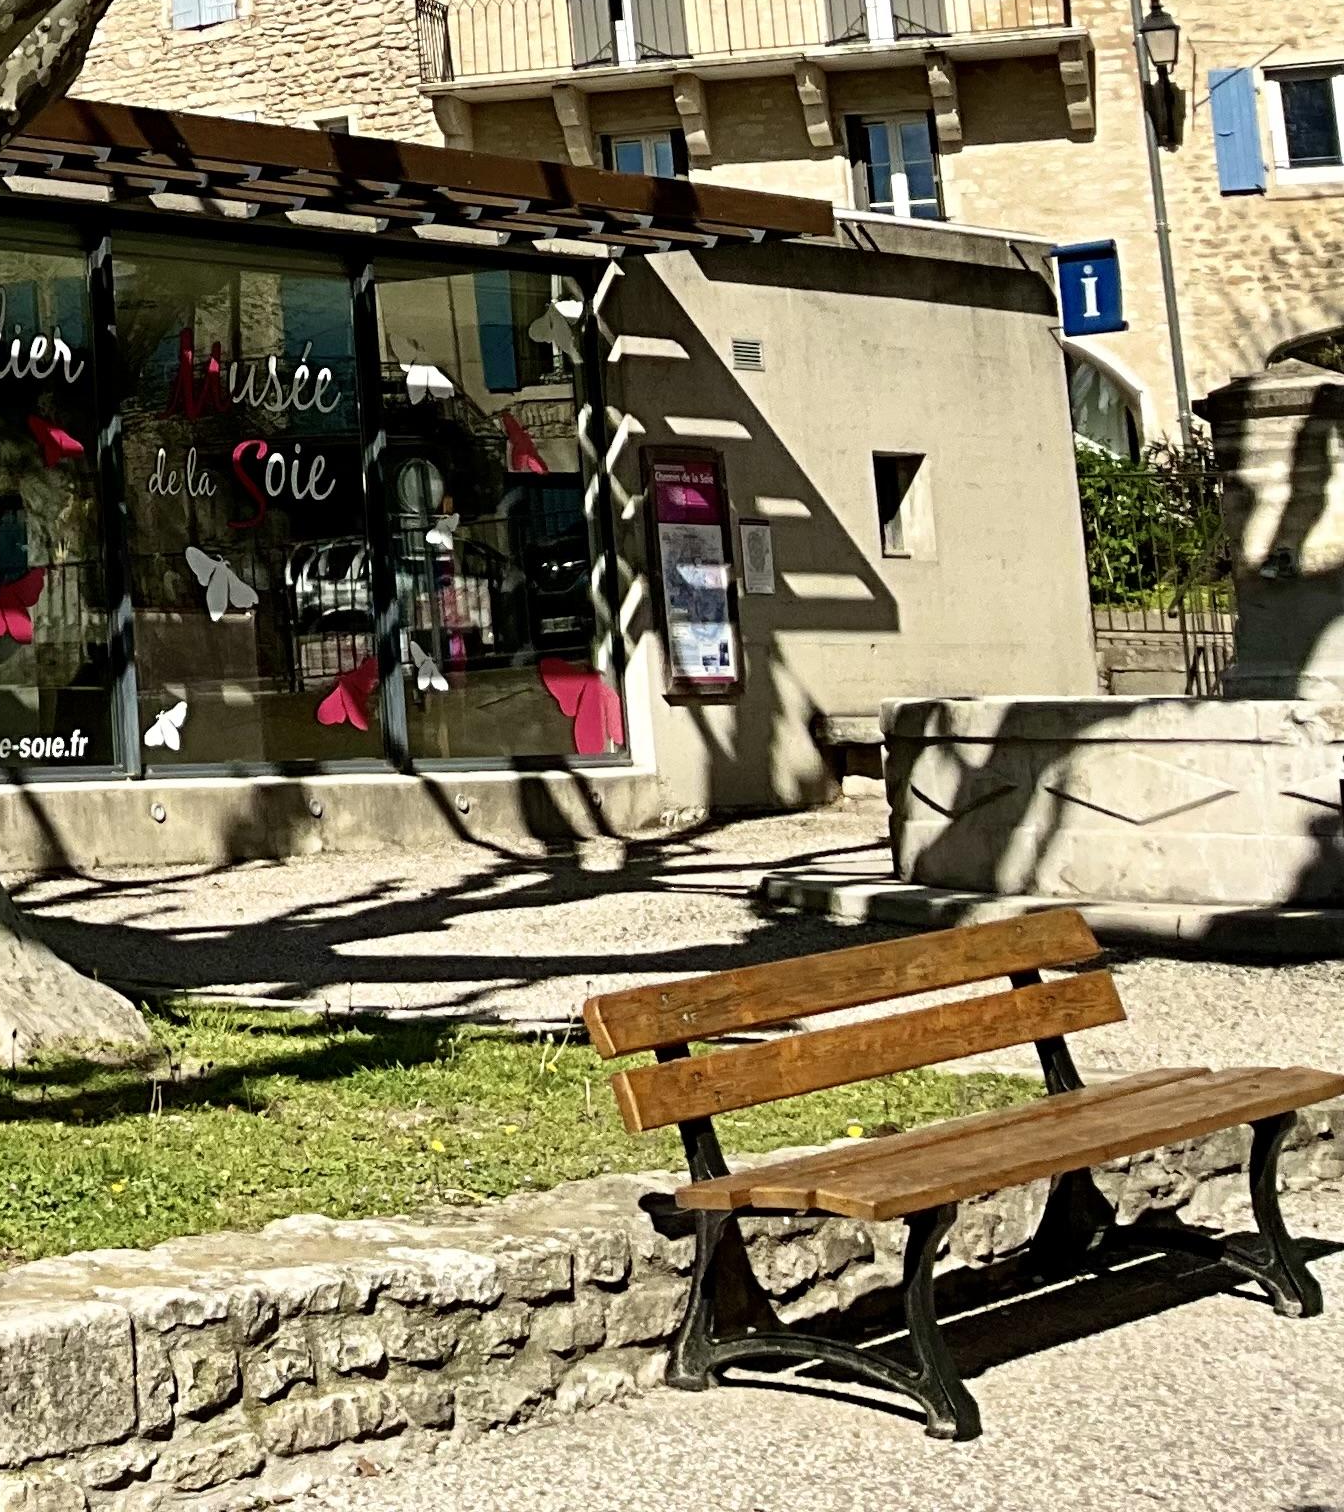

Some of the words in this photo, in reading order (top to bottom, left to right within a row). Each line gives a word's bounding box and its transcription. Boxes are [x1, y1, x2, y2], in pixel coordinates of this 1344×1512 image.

[159, 328, 342, 420] Musée
[148, 447, 183, 496] de
[187, 446, 217, 497] la
[227, 439, 337, 528] Soie
